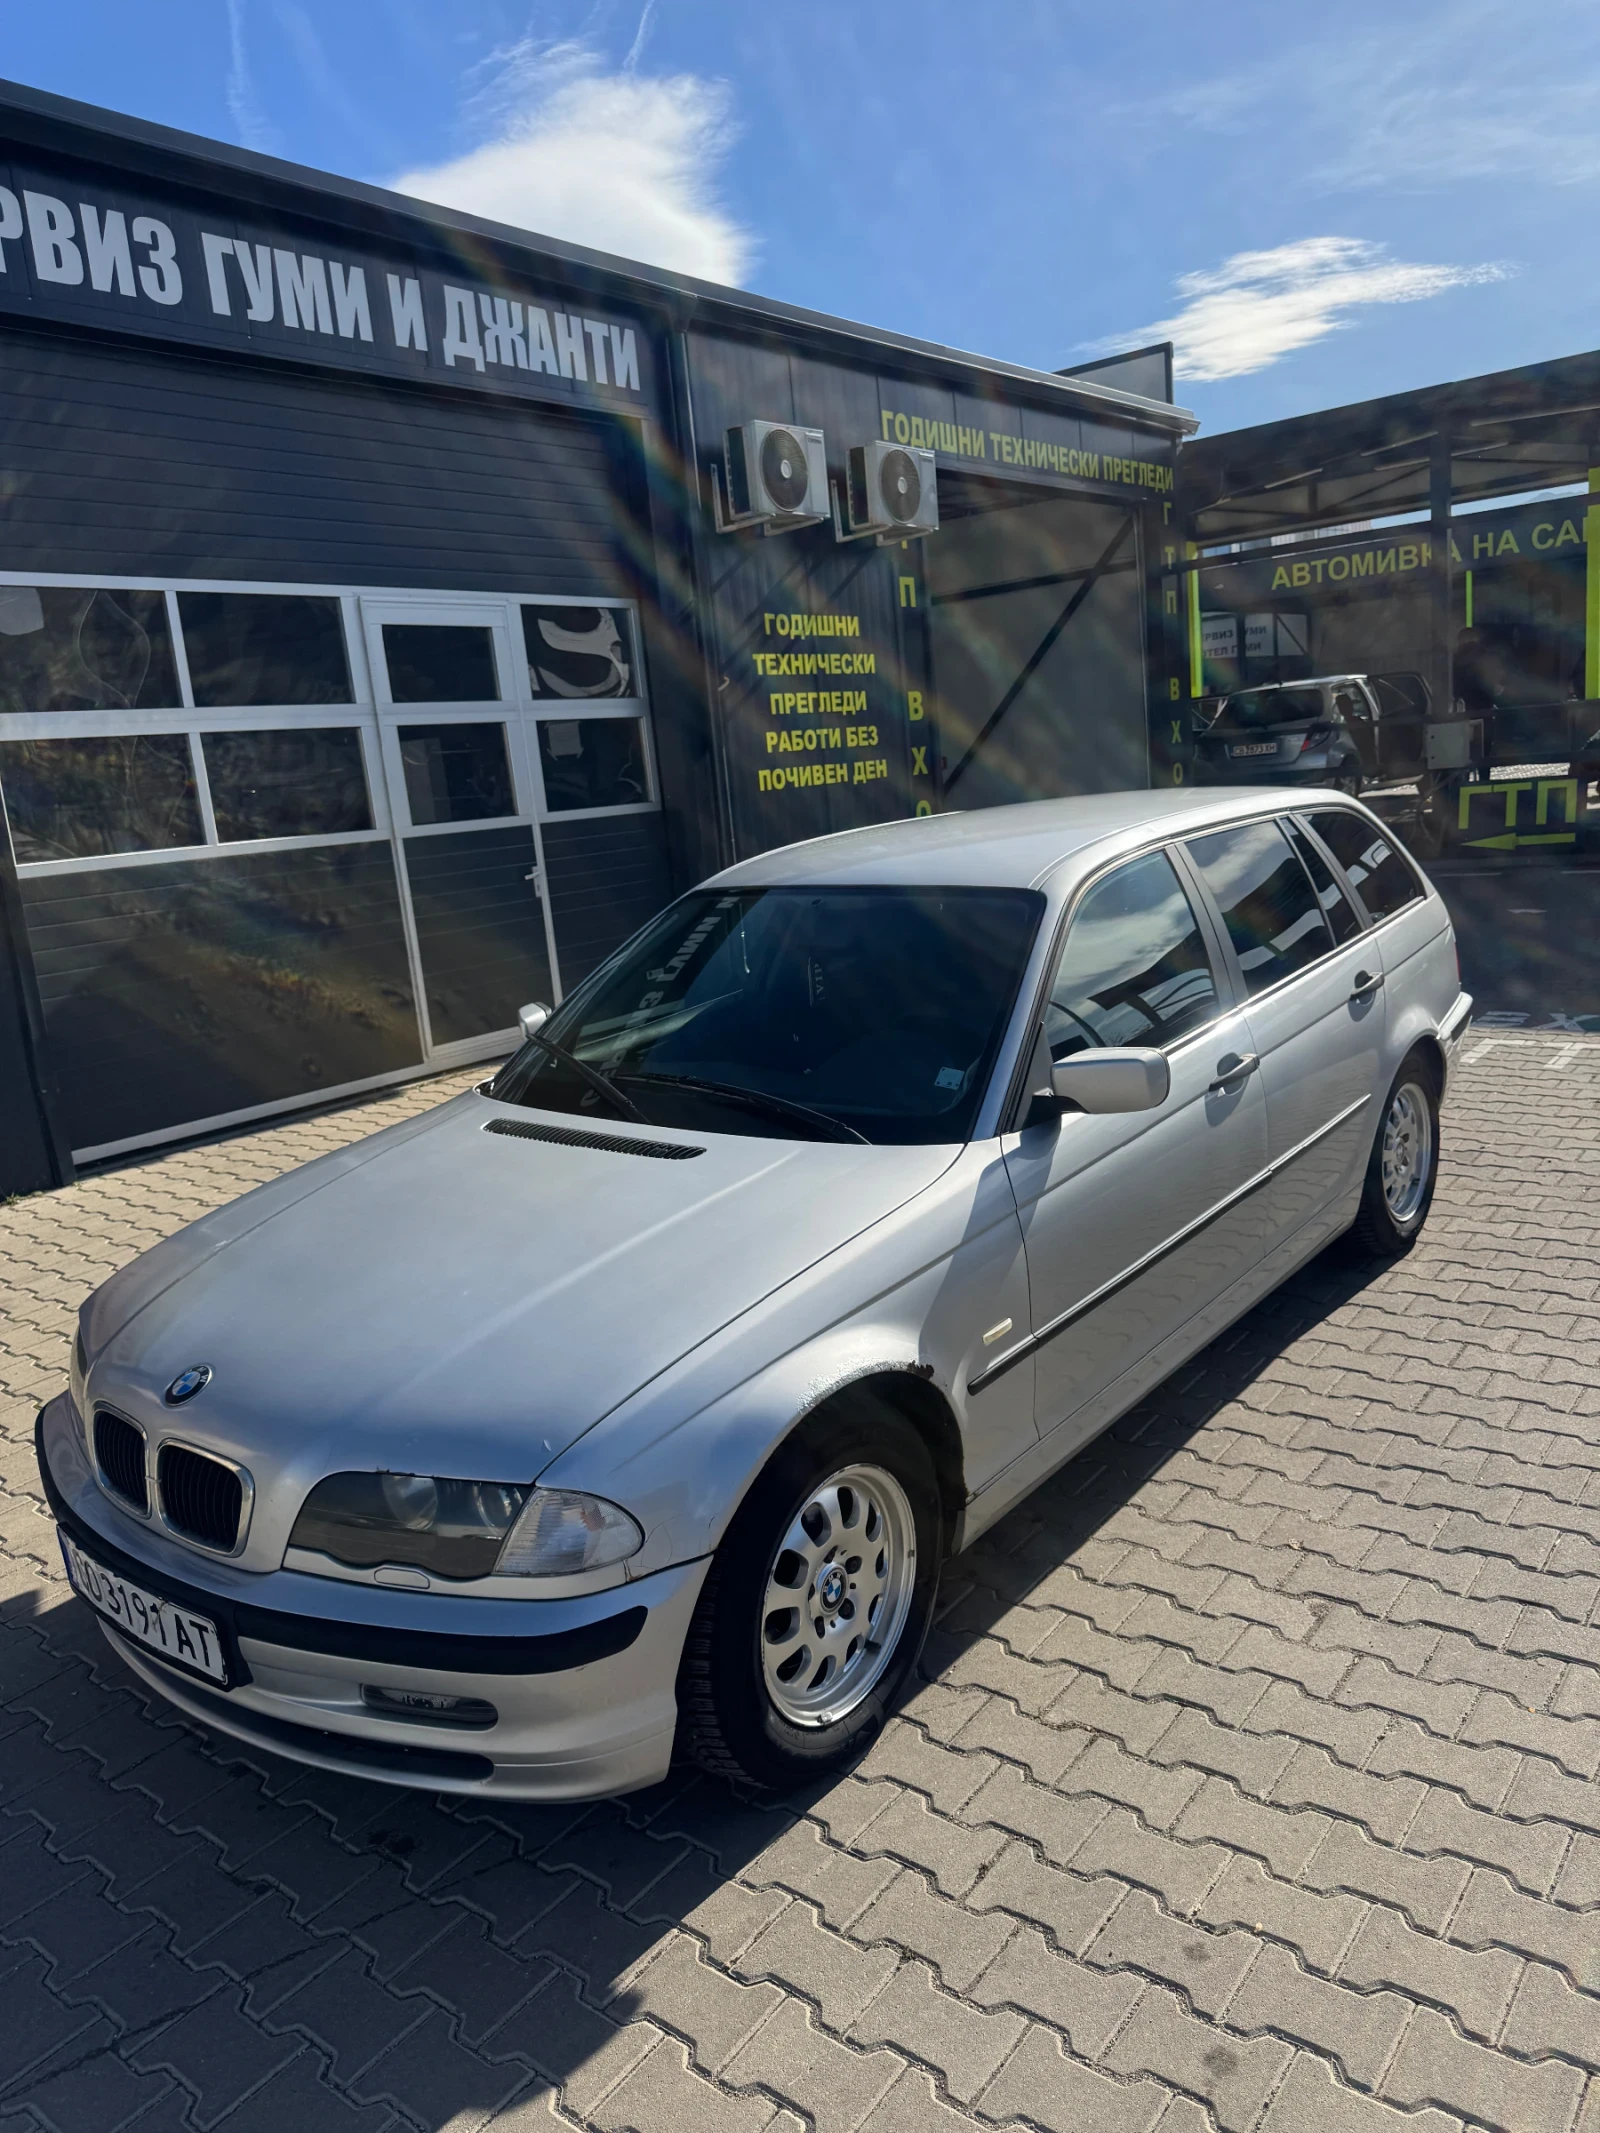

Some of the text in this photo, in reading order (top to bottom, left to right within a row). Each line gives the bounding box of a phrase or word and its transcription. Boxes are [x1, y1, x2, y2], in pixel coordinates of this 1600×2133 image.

[202, 232, 373, 342] ГУМИ
[387, 273, 427, 352] И
[443, 285, 641, 391] ДЖАНТИ
[882, 410, 1173, 492] ГОДИШНИ ТЕХНИЧЕСКИ ПРЕГЛЕДИ
[1473, 529, 1520, 560] НА
[764, 612, 860, 640] ГОДИШНИ
[1202, 629, 1233, 642] РВИЗ
[752, 652, 877, 677] ТЕХНИЧЕСКИ
[769, 690, 867, 716] ПРЕГЛЕДИ
[764, 725, 879, 754] РАБОТИ БЕЗ
[757, 759, 888, 792] ПОЧИВЕН ДЕН
[1458, 779, 1577, 830] ГТП
